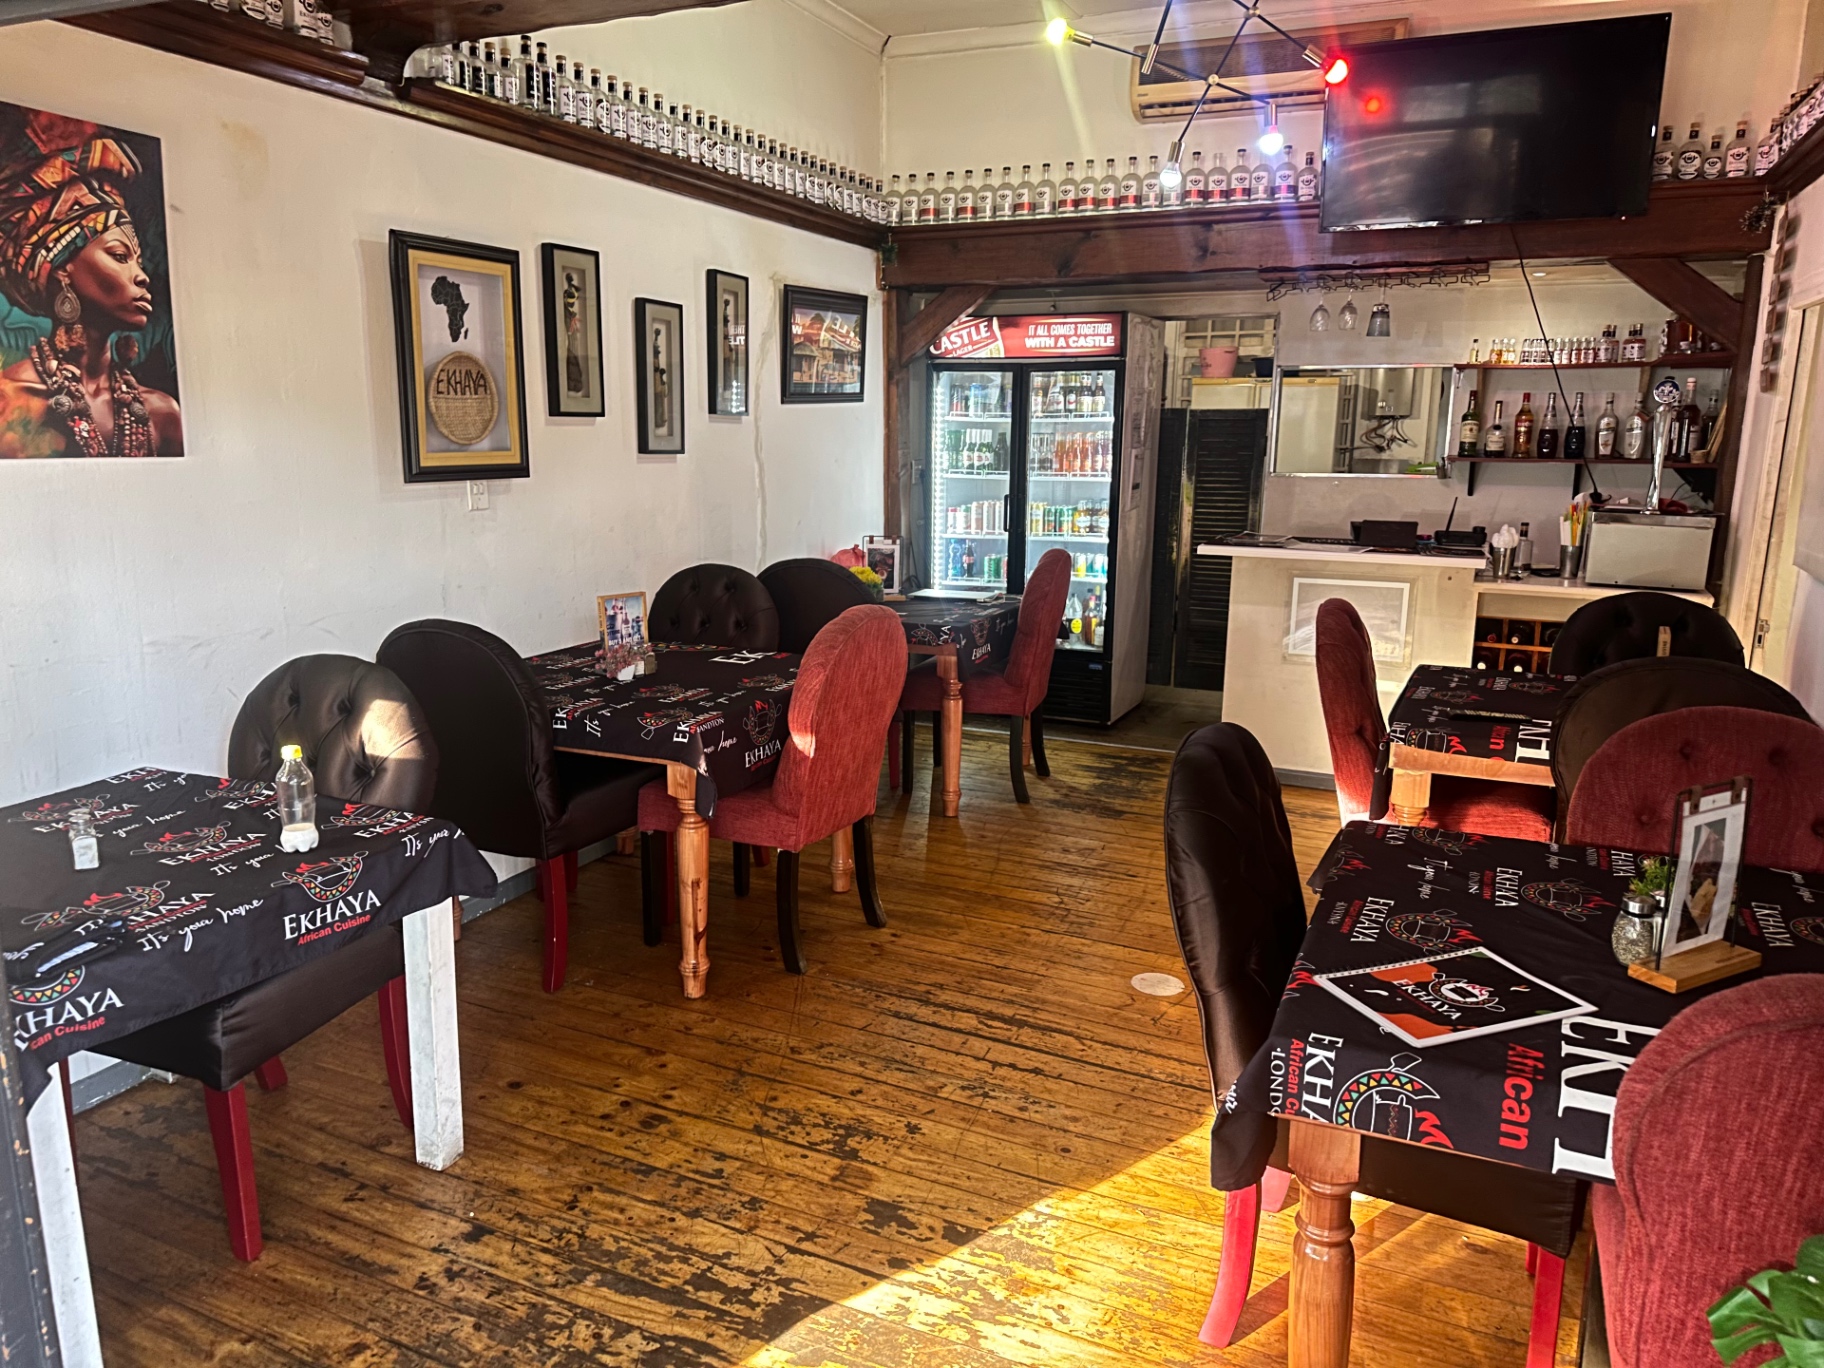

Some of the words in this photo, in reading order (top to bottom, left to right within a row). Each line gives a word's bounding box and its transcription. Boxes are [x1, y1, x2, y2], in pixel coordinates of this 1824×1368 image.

[929, 321, 991, 355] CASTLE
[1024, 337, 1055, 348] WITH
[1056, 337, 1067, 347] A
[1068, 336, 1115, 347] CASTLE
[1028, 325, 1036, 336] IT
[1036, 325, 1049, 336] ALL
[1050, 324, 1075, 335] COMES
[1077, 323, 1112, 335] TOGETHER
[437, 369, 488, 396] EKHAYA
[745, 739, 781, 768] EKHAYA
[33, 803, 141, 833] EKAYA
[159, 833, 267, 866] EKHAYA
[1494, 867, 1523, 907] EKHAYA
[282, 889, 381, 940] EKHAYA
[297, 927, 332, 946] African
[333, 914, 371, 932] Cuisine
[1350, 896, 1394, 942] EKHAYA
[1751, 902, 1796, 947] EKHAYA
[1392, 978, 1462, 1020] EKHAYA
[54, 1016, 105, 1036] Cuisine
[1287, 1038, 1305, 1094] African
[1498, 1043, 1545, 1150] African
